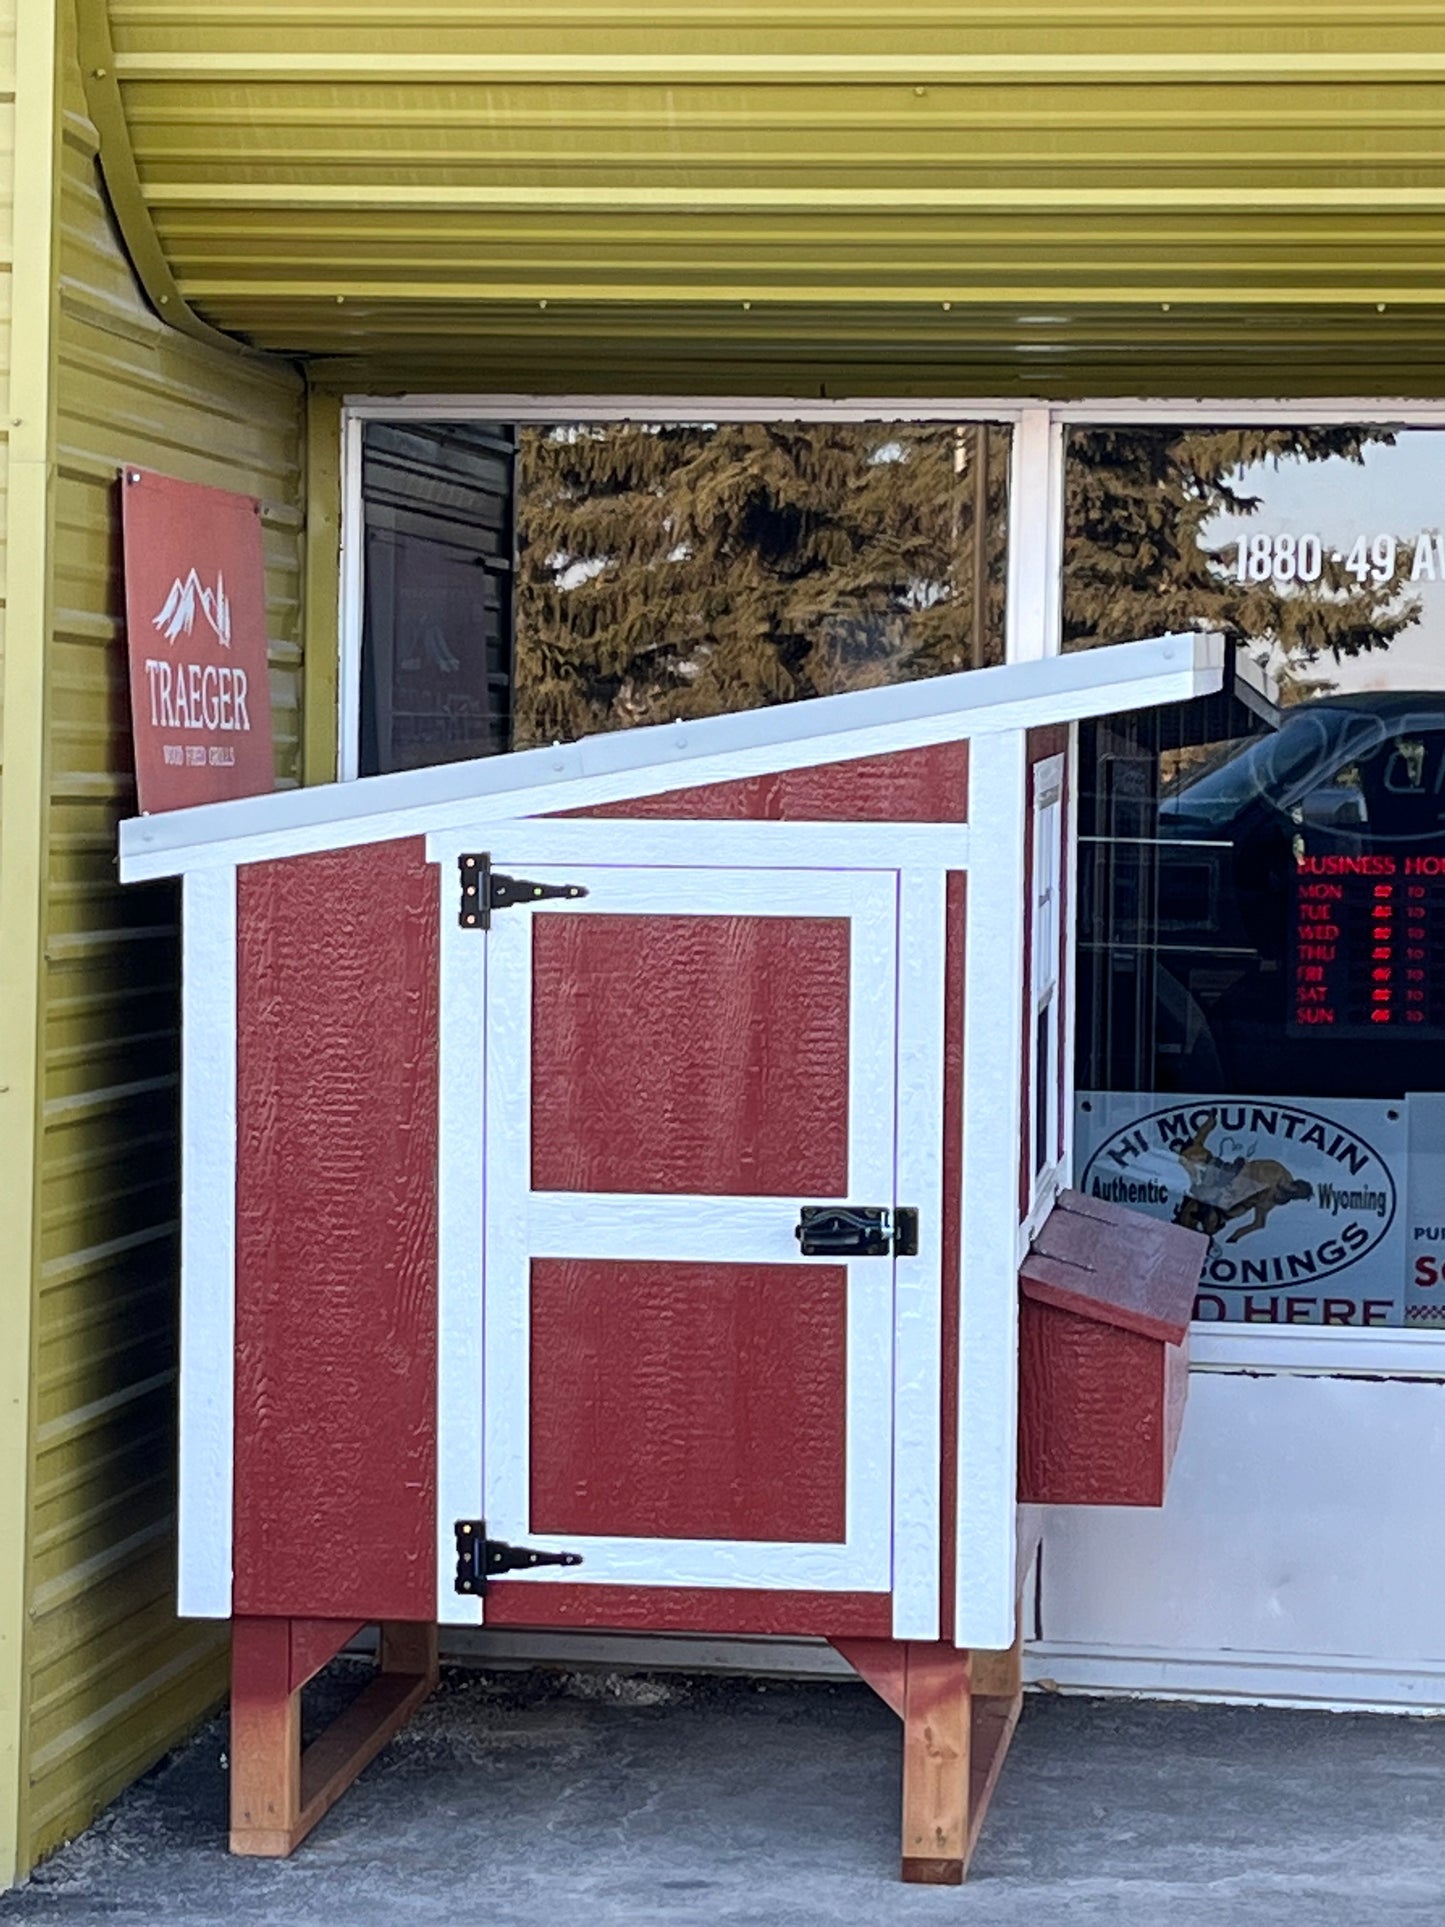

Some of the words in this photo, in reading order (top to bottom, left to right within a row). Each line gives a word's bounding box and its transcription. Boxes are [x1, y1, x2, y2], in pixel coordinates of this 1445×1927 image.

[145, 659, 250, 731] TRAEGER
[1297, 856, 1396, 875] BUSINESS
[1298, 884, 1342, 898] MON
[1300, 904, 1331, 920] TUE
[1297, 945, 1336, 962] THU
[1297, 986, 1328, 1001] SAT
[1297, 1007, 1334, 1024] SUN
[1107, 1130, 1149, 1168] HI
[1156, 1107, 1369, 1175] MOUNTAIN
[1092, 1176, 1168, 1204] Authentic
[1317, 1182, 1386, 1216] Wyoming
